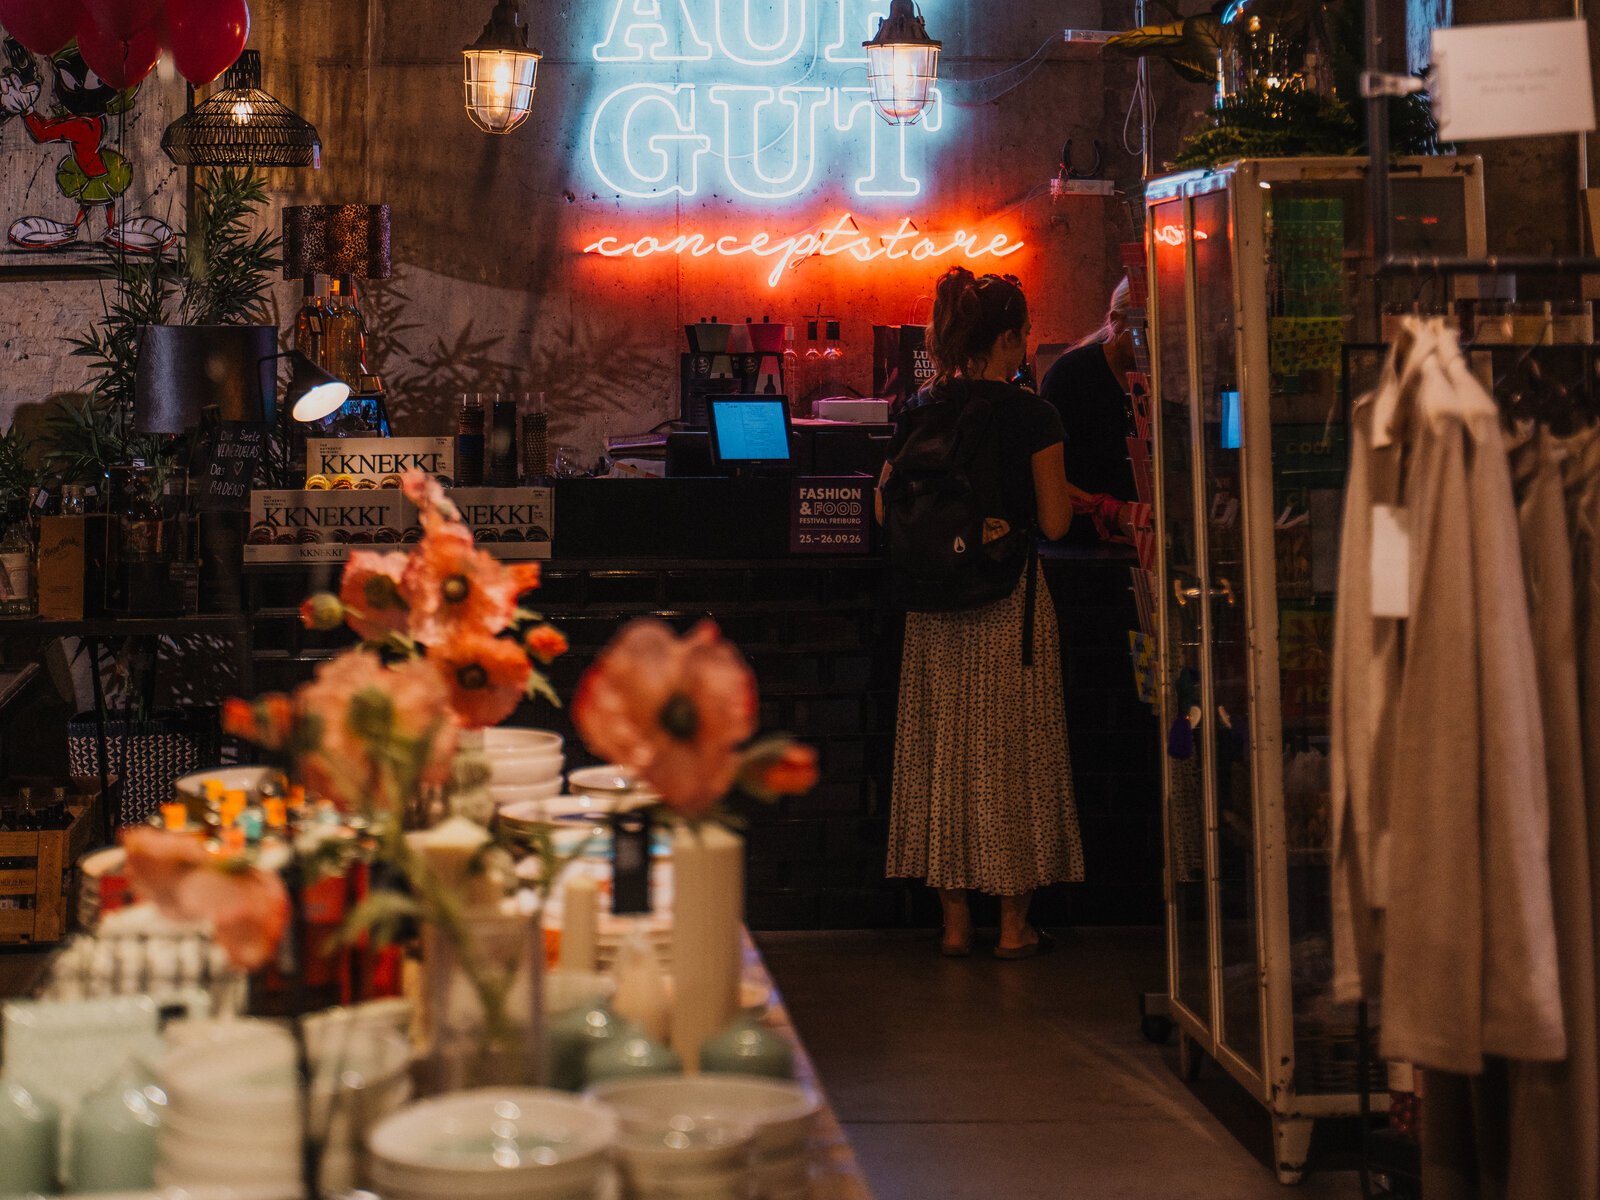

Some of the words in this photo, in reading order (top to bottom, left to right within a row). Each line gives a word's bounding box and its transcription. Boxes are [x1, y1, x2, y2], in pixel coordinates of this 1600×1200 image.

[590, 82, 942, 199] GUT
[583, 212, 1024, 287] conceptstore
[239, 429, 261, 442] Seele
[217, 443, 260, 458] VENEZUELAS
[210, 463, 225, 476] Das
[320, 453, 441, 474] KKNEKKI
[209, 480, 245, 498] BADENS
[799, 487, 862, 500] FASHION
[264, 506, 386, 527] KKNEKKI
[456, 504, 536, 525] NEKKI
[799, 501, 812, 516] &
[814, 501, 862, 516] FOOD
[799, 517, 828, 525] FESTIVAL
[829, 517, 862, 525] FREIBURG
[299, 548, 344, 558] KKNEKKI
